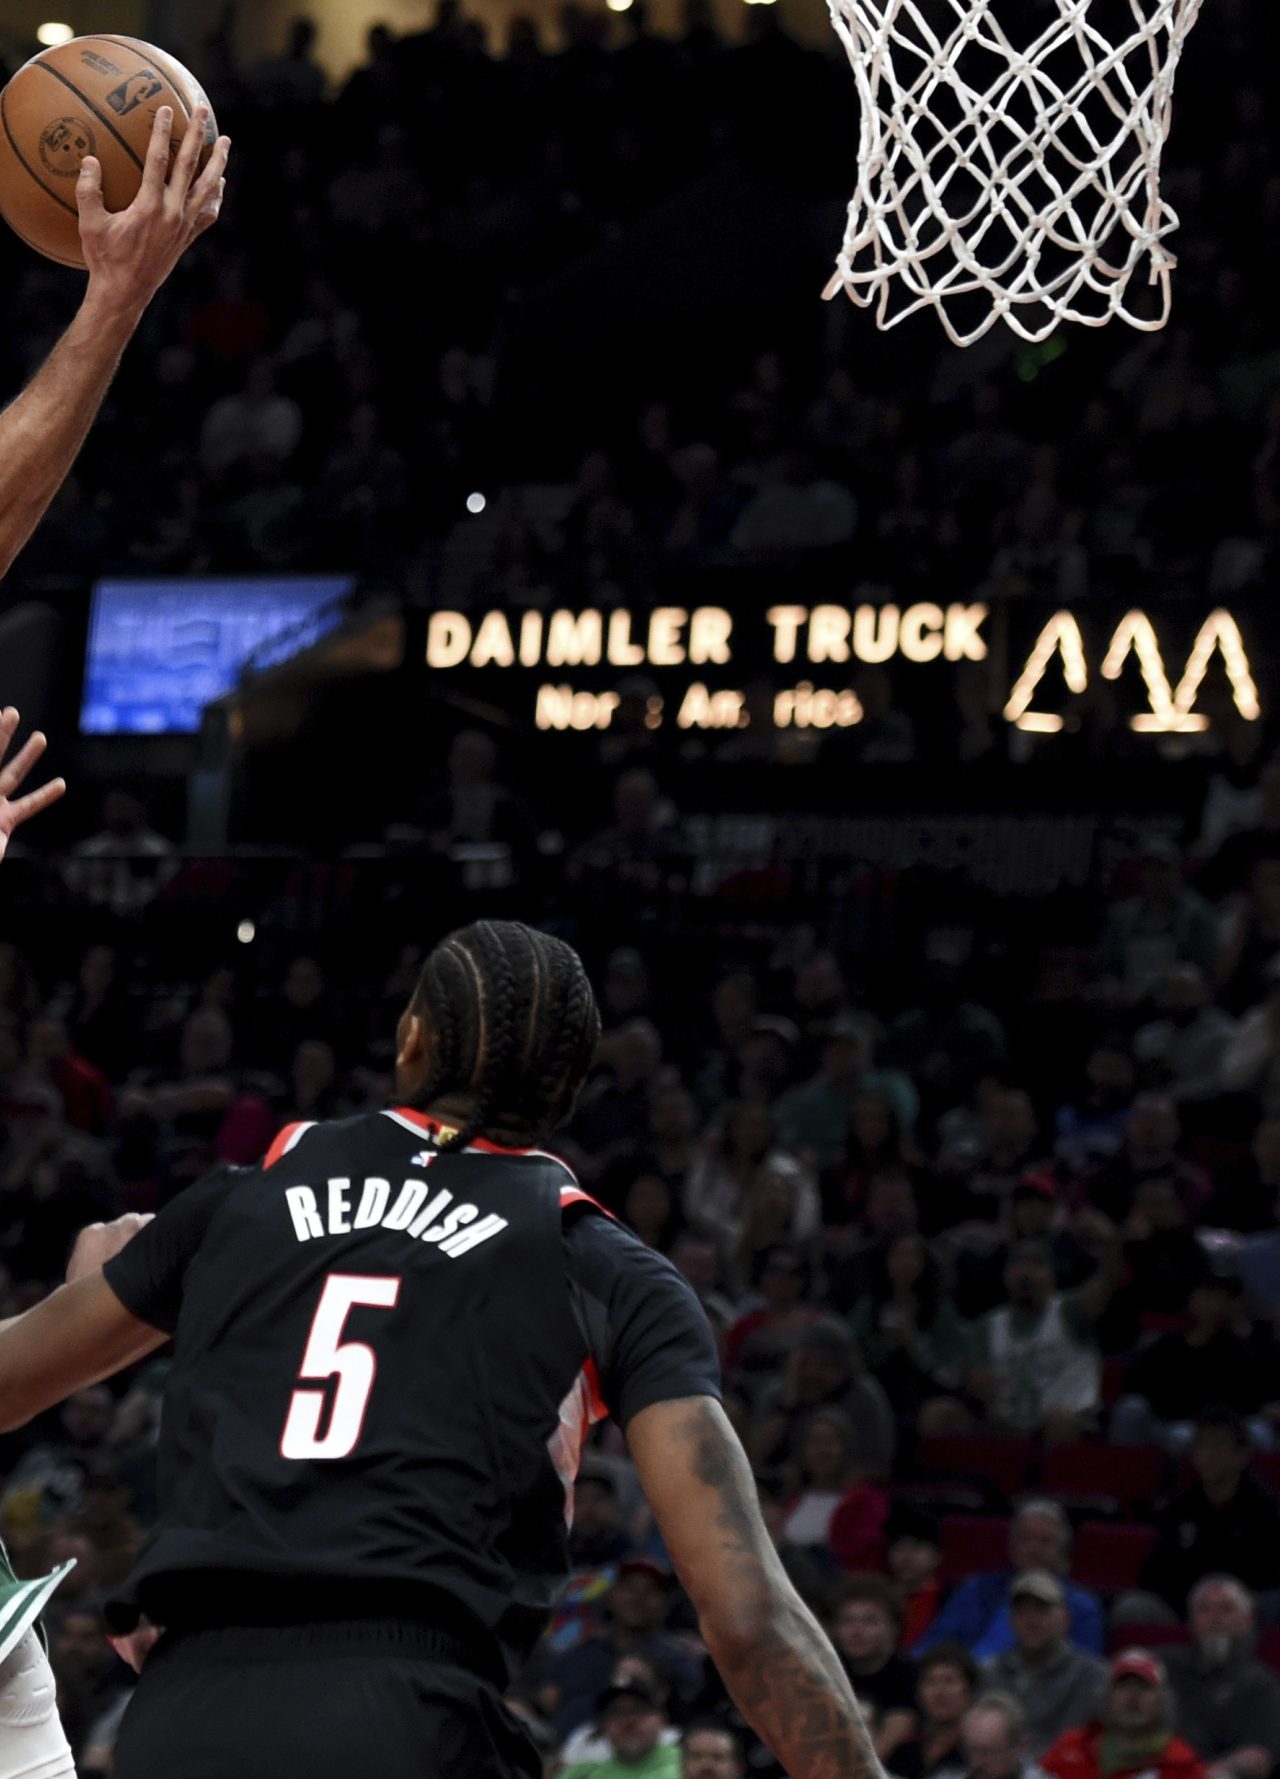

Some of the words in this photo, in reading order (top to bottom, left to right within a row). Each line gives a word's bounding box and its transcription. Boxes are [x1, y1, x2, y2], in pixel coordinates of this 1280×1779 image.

[426, 606, 732, 668] DAIMLER
[768, 603, 987, 664] TRUCK
[284, 1177, 509, 1259] REDDISH
[280, 1273, 401, 1460] 5
